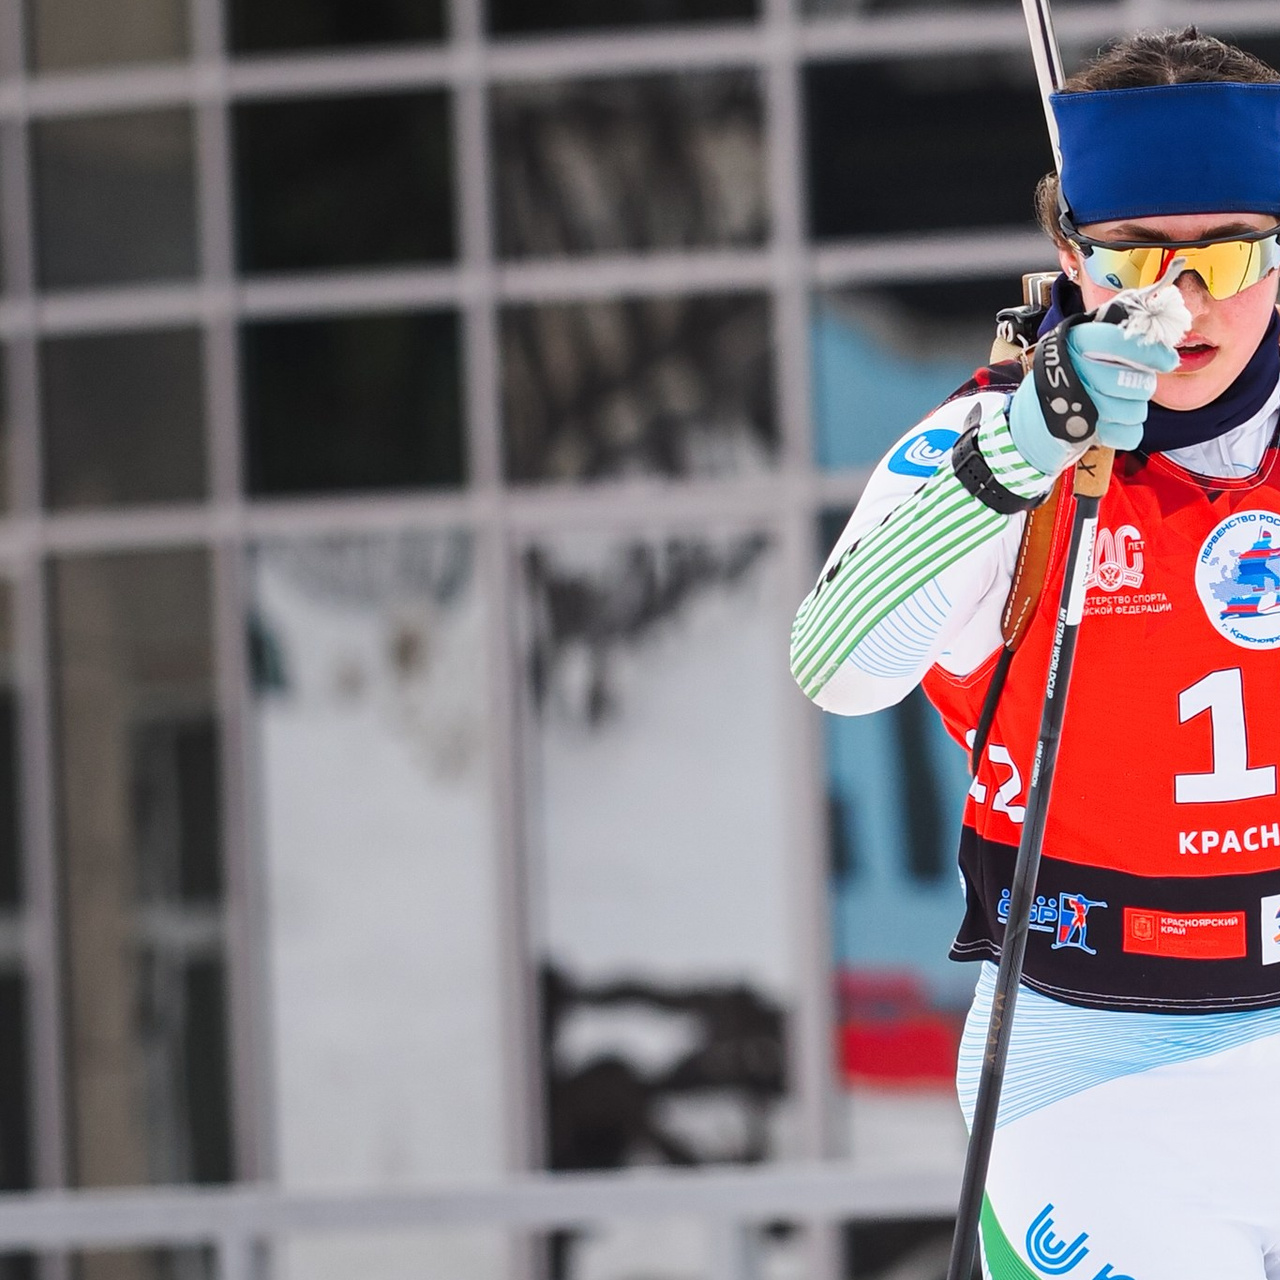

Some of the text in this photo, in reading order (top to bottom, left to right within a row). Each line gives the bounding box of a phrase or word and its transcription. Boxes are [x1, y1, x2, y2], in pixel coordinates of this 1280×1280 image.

[1201, 514, 1256, 564] ПЕРВЕНСТВО
[1128, 541, 1145, 551] ЛЕТ
[1133, 593, 1167, 603] СПОРТА
[1115, 603, 1172, 614] ФЕДЕРАЦИИ
[1055, 621, 1066, 644] STAR
[1161, 916, 1239, 928] КРАСНОЯРСКИЙ
